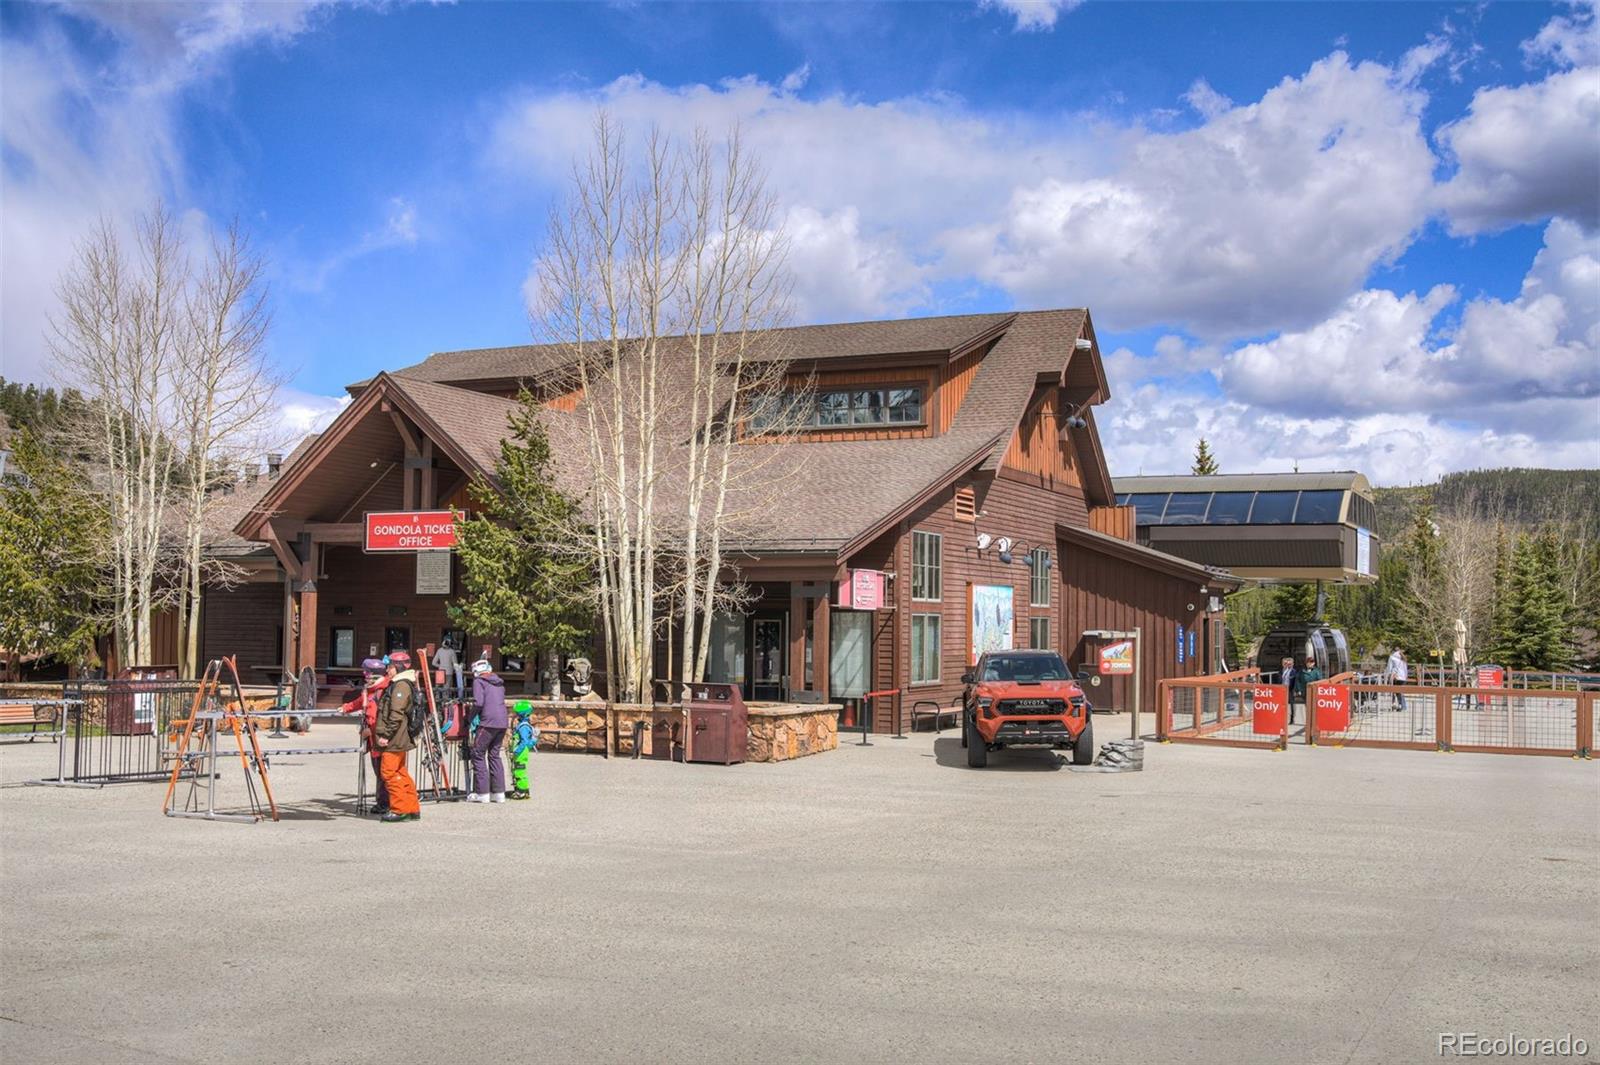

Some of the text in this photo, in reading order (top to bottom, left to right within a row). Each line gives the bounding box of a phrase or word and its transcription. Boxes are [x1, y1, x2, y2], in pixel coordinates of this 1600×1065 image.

[374, 524, 421, 535] GONDOLA
[399, 536, 432, 546] OFFICE
[1254, 688, 1273, 697] Exit
[1317, 687, 1337, 696] Exit
[1254, 702, 1279, 713] Only
[1317, 699, 1342, 710] Only
